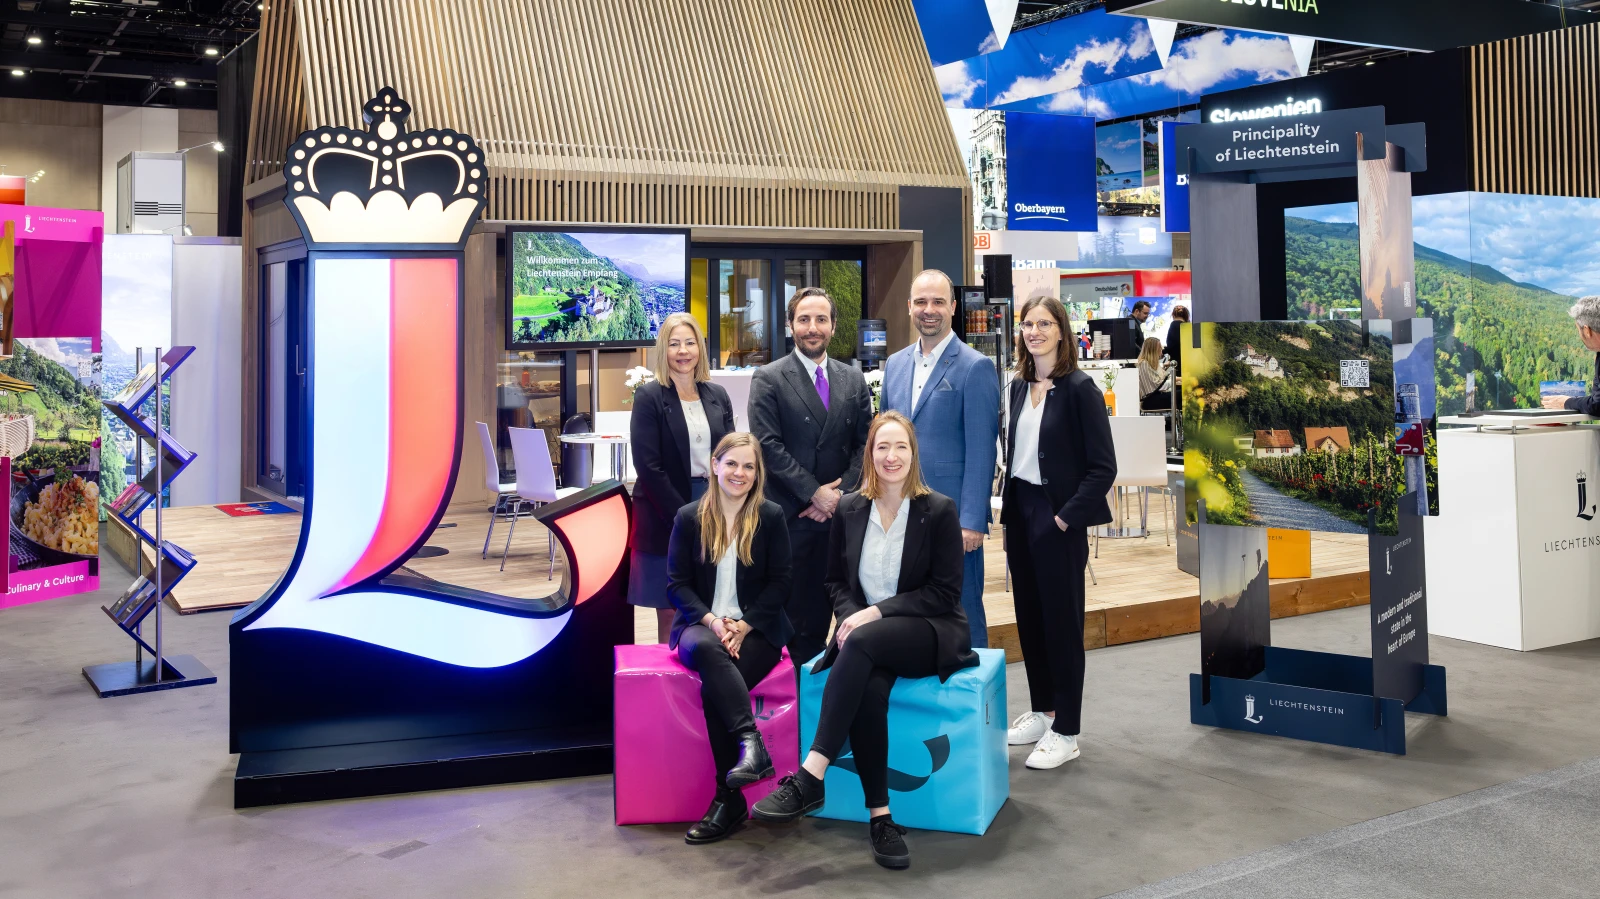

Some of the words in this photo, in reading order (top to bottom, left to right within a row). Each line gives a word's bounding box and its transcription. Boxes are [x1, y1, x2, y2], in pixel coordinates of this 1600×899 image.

[1221, 0, 1319, 14] ENIA
[1232, 123, 1320, 142] Principality
[1215, 148, 1231, 162] of
[1235, 140, 1340, 161] Liechtenstein
[1014, 203, 1066, 215] Oberbayern
[526, 255, 579, 264] Willkommen
[526, 269, 581, 277] Liechtenstein
[582, 269, 618, 279] Empfang
[44, 579, 51, 588] &
[52, 574, 84, 586] Culture
[1381, 606, 1397, 623] modern
[1403, 586, 1423, 607] traditional
[1391, 621, 1401, 634] state
[1387, 639, 1399, 655] heart
[1403, 628, 1416, 644] Europe
[1269, 698, 1344, 715] LIECHTENSTEIN
